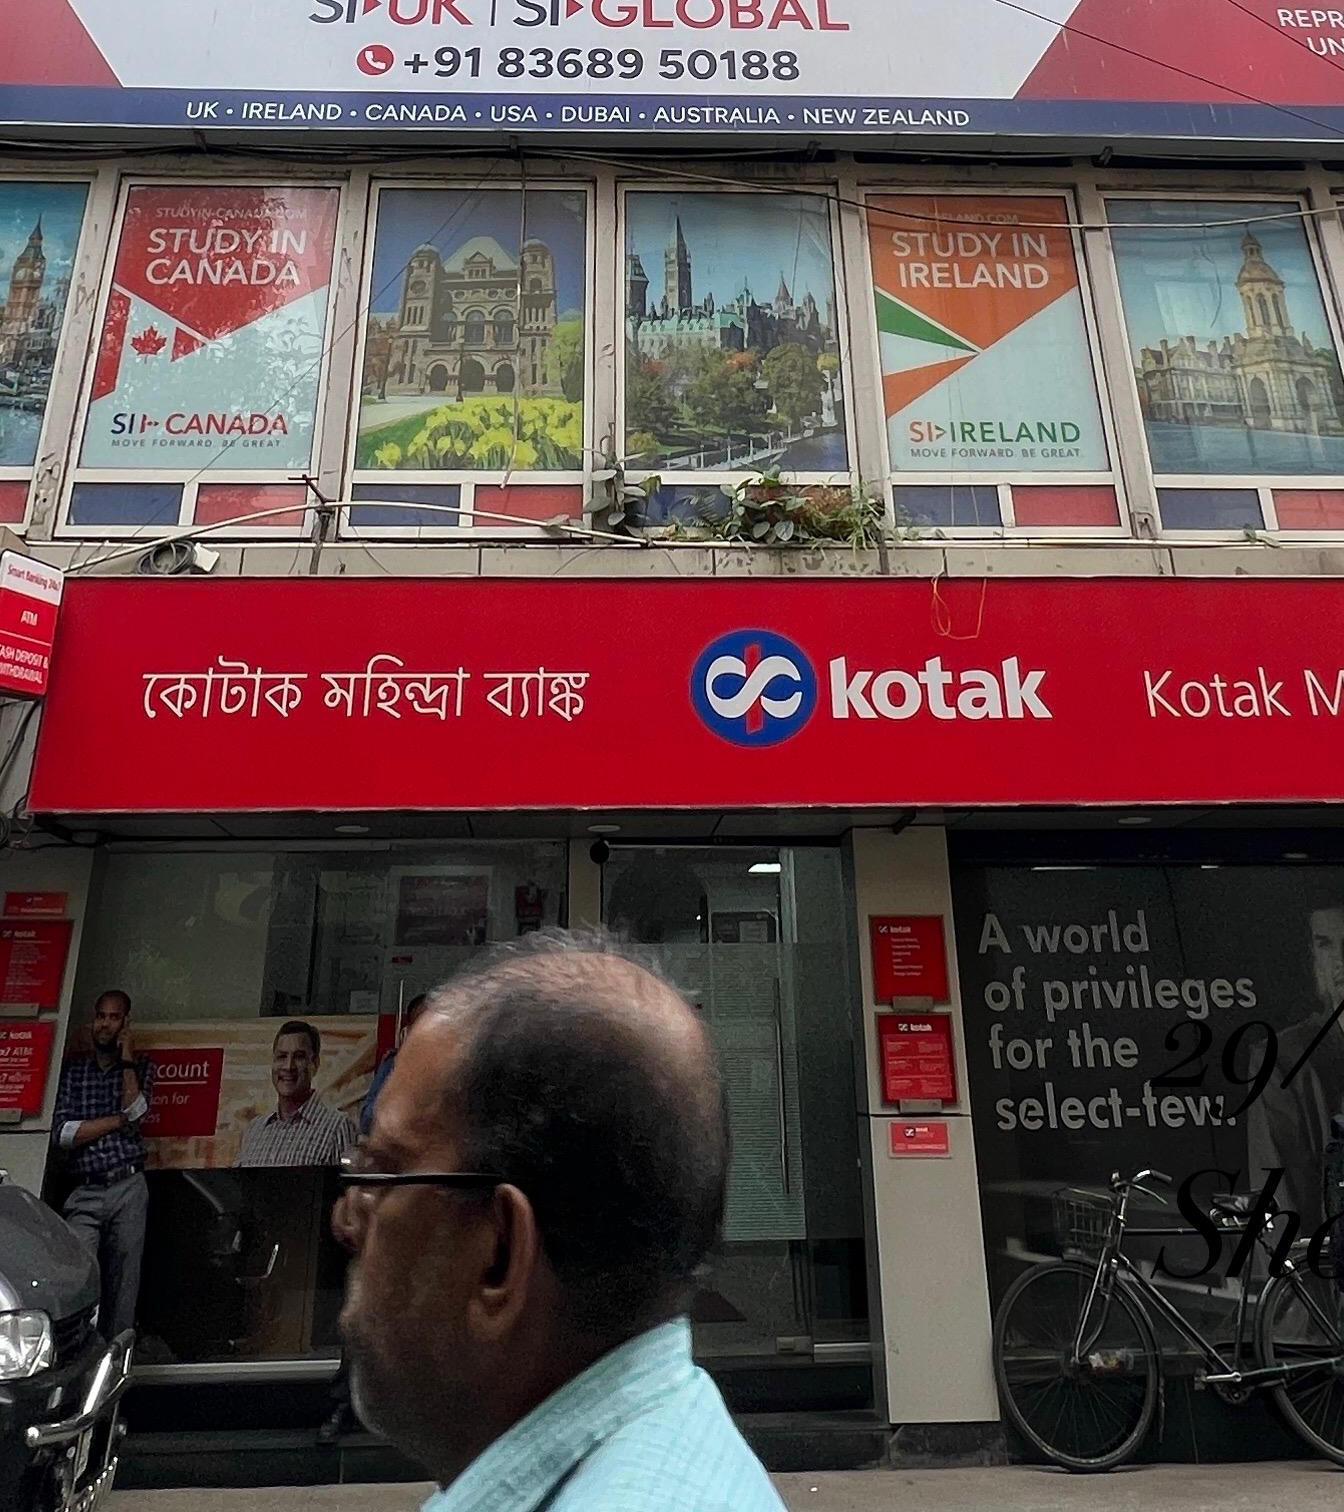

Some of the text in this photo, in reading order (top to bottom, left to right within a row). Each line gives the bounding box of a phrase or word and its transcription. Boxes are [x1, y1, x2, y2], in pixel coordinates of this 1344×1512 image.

[403, 48, 801, 82] +91 83689 50188
[186, 101, 971, 129] UK IRELAND CANADA USA DUBAI AUSTRALIA NEW ZEALAND
[147, 228, 306, 255] STUDY IN
[891, 231, 1048, 258] STUDY IN
[145, 259, 302, 286] CANADA
[899, 263, 1049, 289] IRELAND
[111, 438, 147, 448] MOVE
[222, 438, 236, 448] BE
[910, 448, 947, 458] MOVE
[1022, 448, 1037, 458] BE
[20, 610, 38, 626] ATM
[15, 649, 44, 668] DEPOSIT
[142, 654, 590, 722] কোটাক মহিন্দ্রা ব্যাঙ্ক
[830, 656, 1052, 722] kotak
[1144, 668, 1292, 720] Kotak
[977, 909, 1150, 955] A world
[984, 964, 1257, 1022] of privileges
[988, 1023, 1054, 1070] for
[1067, 1022, 1140, 1068] the
[154, 1060, 211, 1079] count
[172, 1092, 191, 1106] for
[995, 1080, 1238, 1131] select-few.
